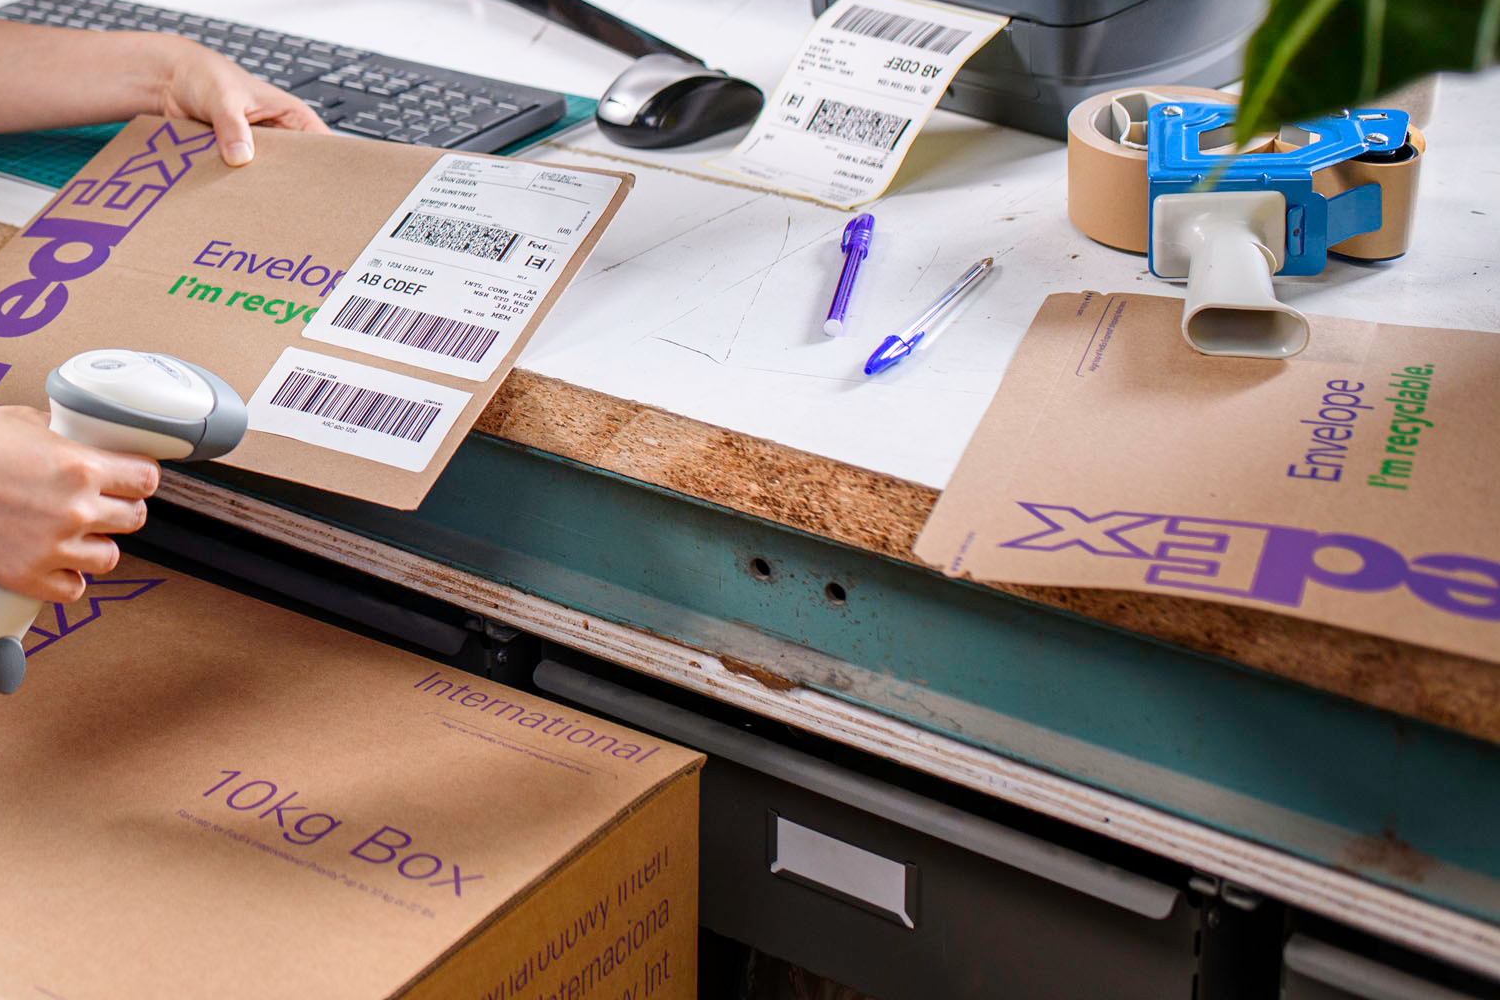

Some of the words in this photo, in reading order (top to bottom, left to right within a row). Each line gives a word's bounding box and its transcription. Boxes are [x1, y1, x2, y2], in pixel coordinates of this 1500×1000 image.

[884, 56, 921, 75] CDEF
[921, 63, 943, 79] AB
[430, 186, 441, 194] 123
[441, 188, 478, 198] SUNSTREET
[455, 179, 478, 187] GREEN
[556, 226, 572, 237] (US)
[193, 240, 347, 297] Envelop
[386, 260, 401, 270] 1234
[402, 263, 418, 273] 1234
[418, 266, 435, 276] 1234
[357, 272, 382, 287] AB
[383, 277, 428, 296] CDEF
[463, 279, 484, 290] INTL
[487, 285, 510, 296] CONN
[512, 290, 535, 302] PLUS
[526, 288, 538, 296] AA
[225, 291, 319, 324] recyc
[490, 311, 513, 322] MEM
[494, 303, 525, 316] 38103
[1384, 363, 1436, 456] recyclable.
[1286, 379, 1375, 483] Envelope
[997, 500, 1500, 623] edEx
[413, 671, 662, 764] International
[203, 770, 344, 845] 10kg
[349, 825, 485, 898] Box
[538, 898, 669, 1000] ternaciona
